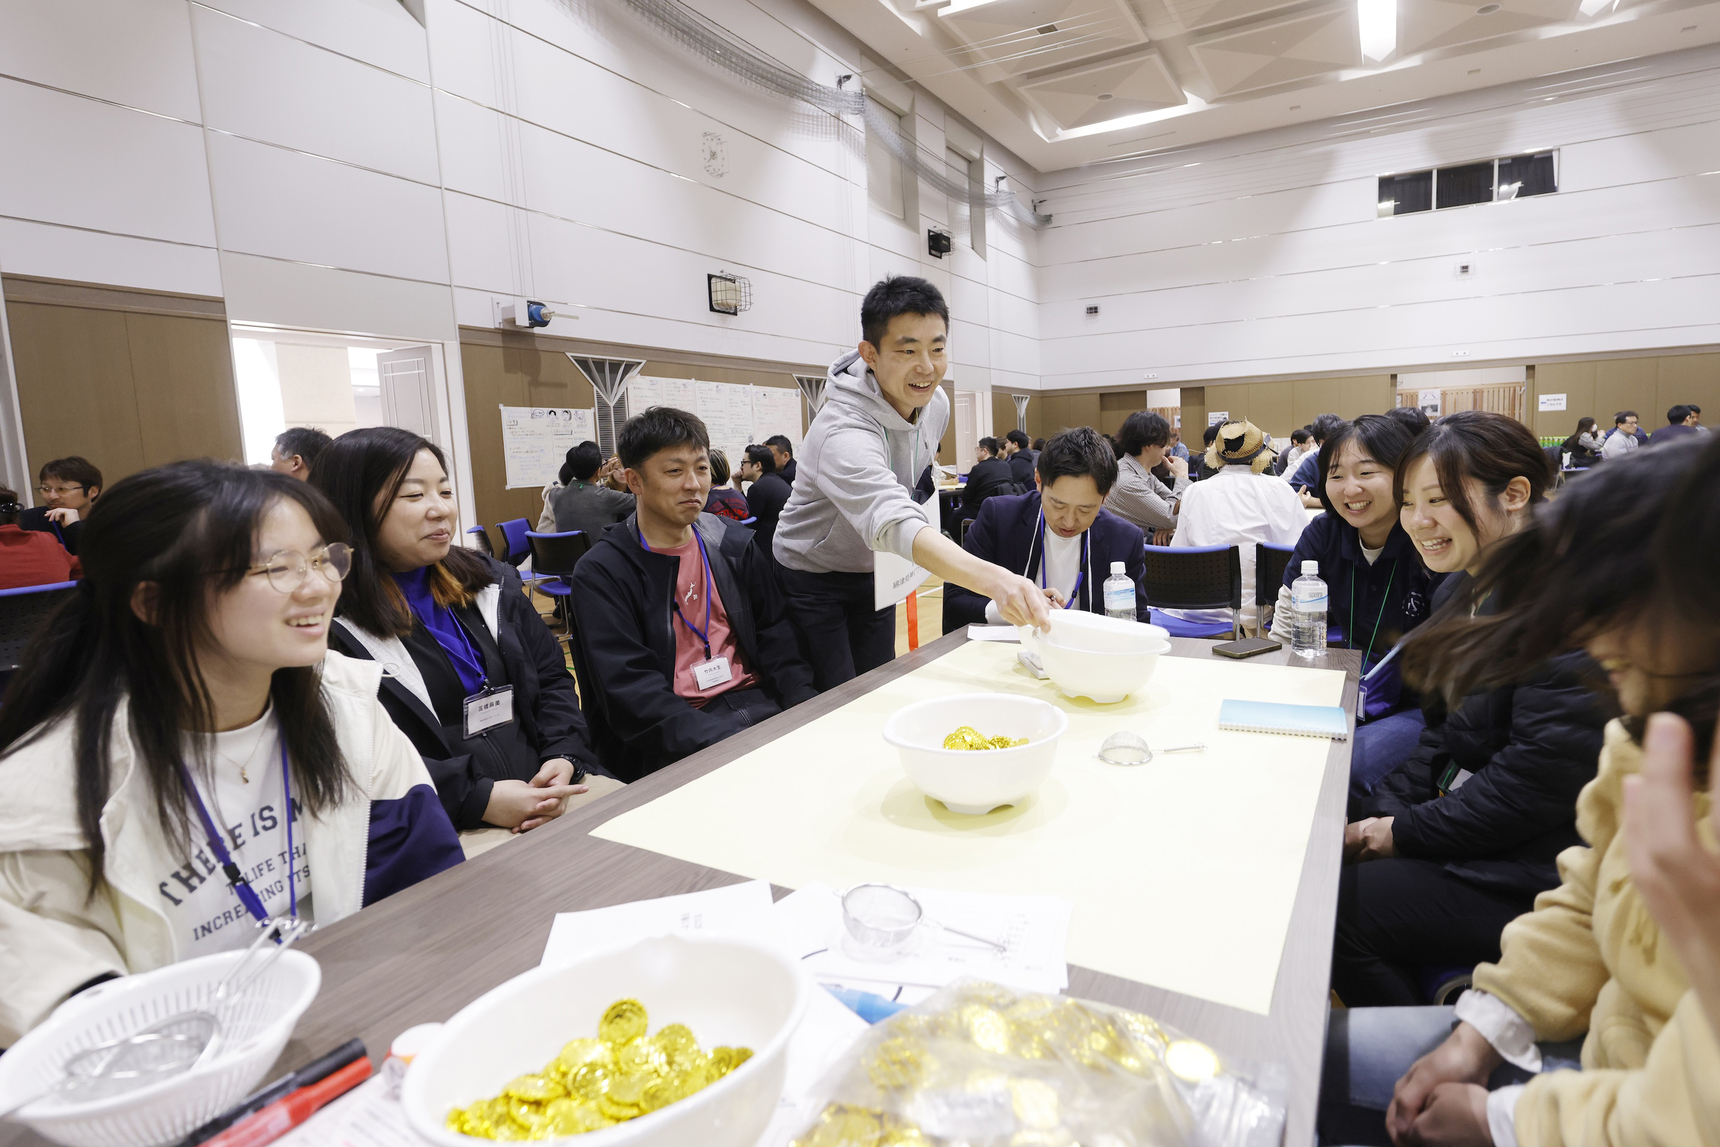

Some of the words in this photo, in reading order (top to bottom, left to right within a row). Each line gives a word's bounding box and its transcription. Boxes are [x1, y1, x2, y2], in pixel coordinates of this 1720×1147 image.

[158, 822, 246, 907] THEE
[250, 805, 278, 837] IS
[243, 858, 275, 884] LIFE
[192, 880, 284, 941] INCREING
